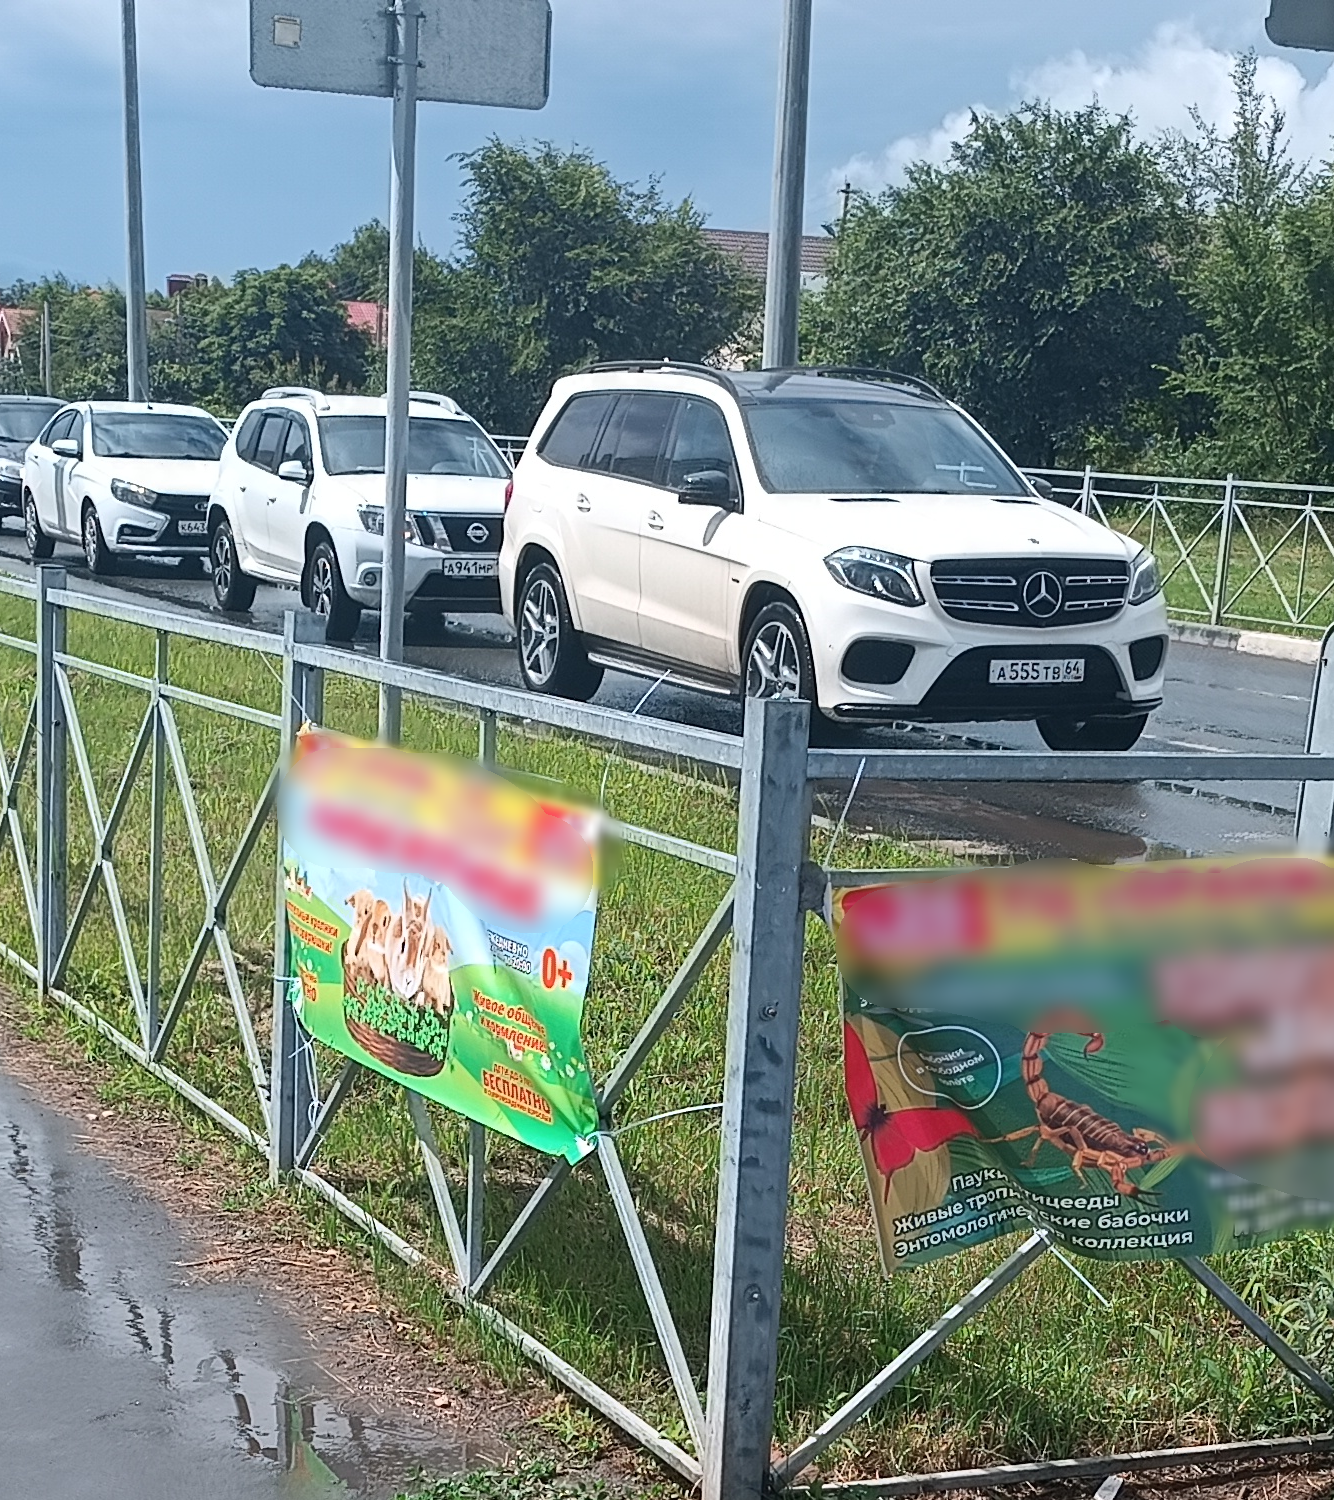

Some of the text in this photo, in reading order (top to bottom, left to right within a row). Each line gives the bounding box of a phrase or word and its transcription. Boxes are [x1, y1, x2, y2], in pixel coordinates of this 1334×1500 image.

[543, 948, 573, 989] 0+
[483, 1069, 551, 1115] БЕСПЛАТНО
[894, 1201, 964, 1236] Живые
[1097, 1208, 1190, 1230] бабочки
[1072, 1230, 1194, 1251] коллекция
